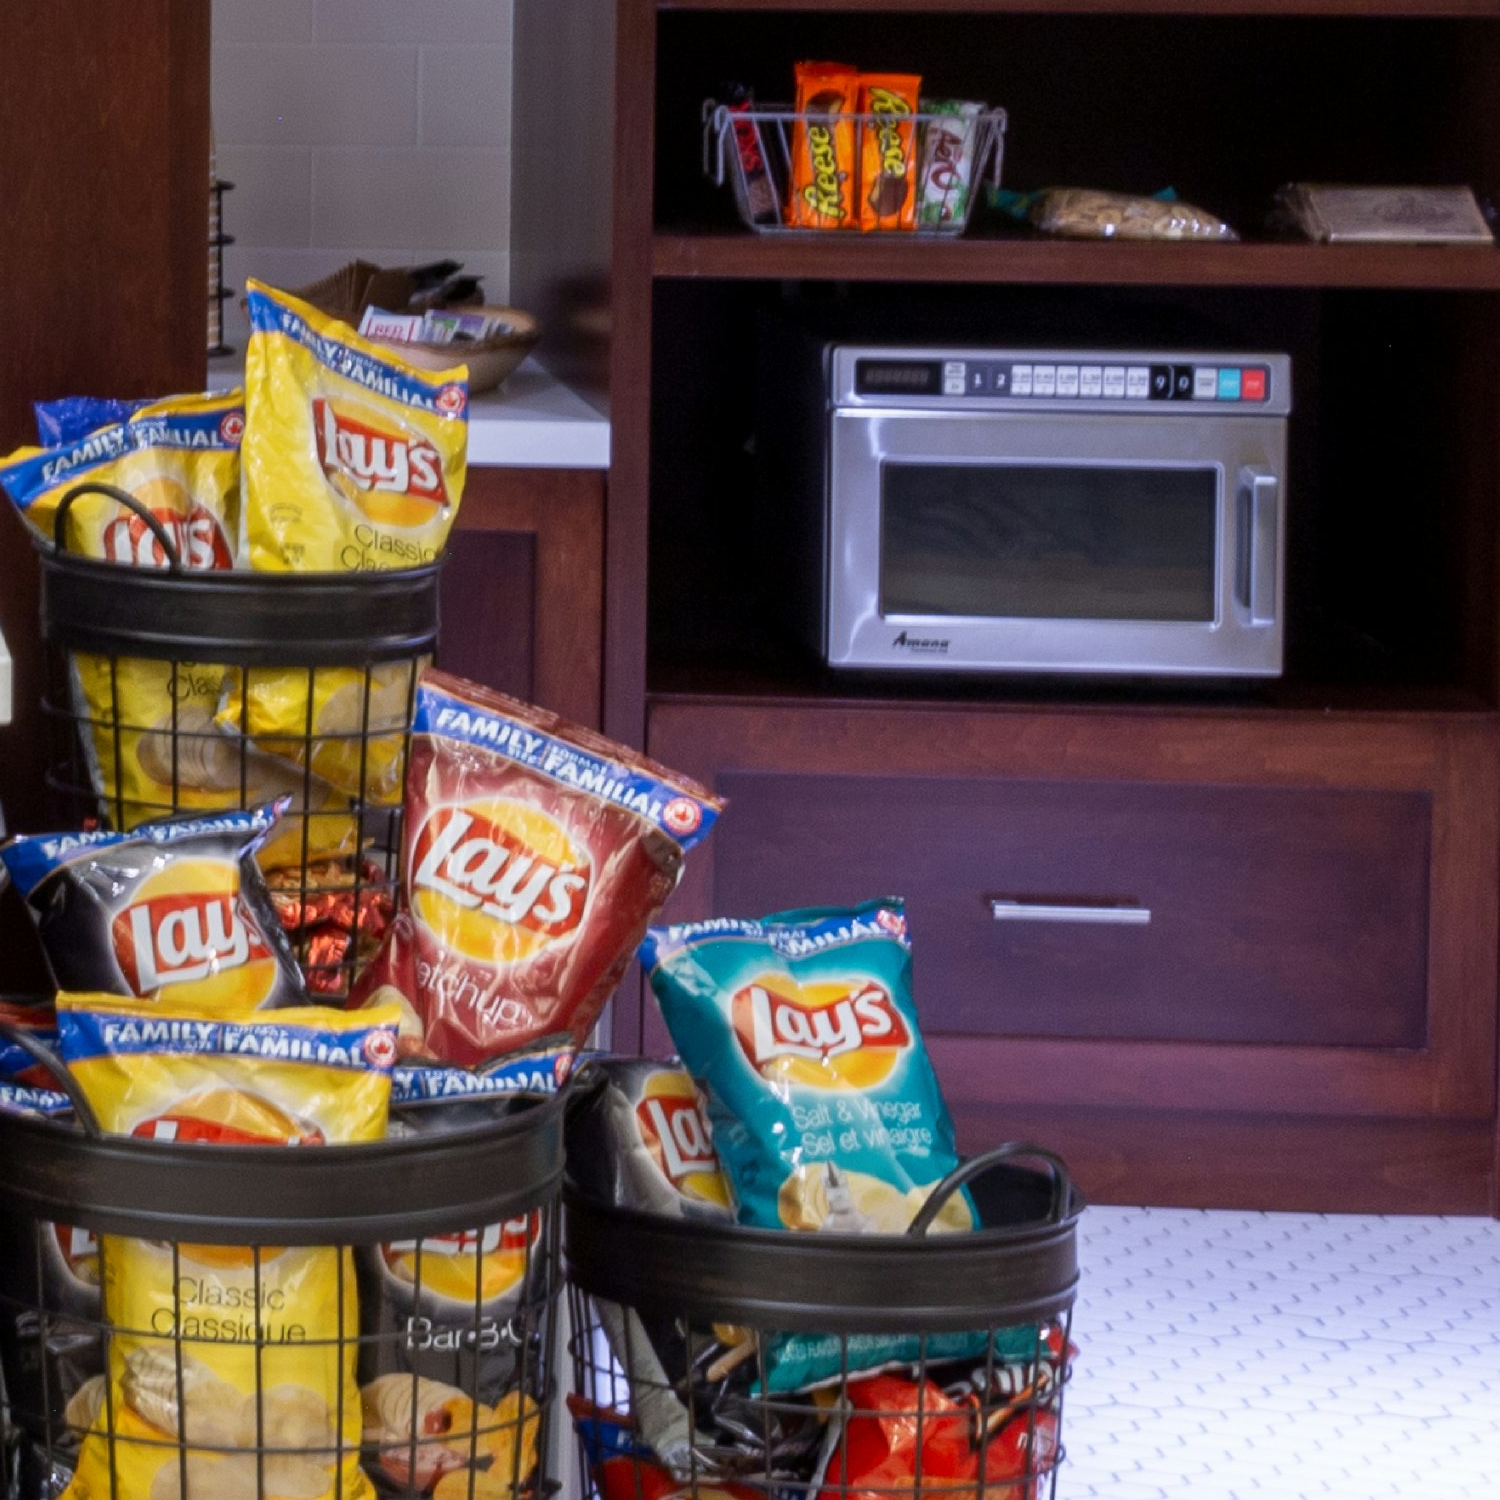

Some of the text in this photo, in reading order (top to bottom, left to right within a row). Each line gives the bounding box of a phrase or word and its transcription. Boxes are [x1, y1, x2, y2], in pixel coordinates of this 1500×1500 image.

[41, 427, 128, 483] FAMILY
[312, 399, 444, 494] Lay's
[436, 707, 663, 821] FAMILY FAMILIAL
[413, 809, 588, 923] Lay's
[103, 1022, 365, 1067] FAMILY FAMILIAL
[749, 984, 893, 1061] Lay's
[653, 1097, 714, 1179] La
[792, 1104, 833, 1130] Salt
[838, 1103, 853, 1124] &
[801, 1132, 836, 1156] Sel
[841, 1131, 860, 1152] et
[171, 1275, 286, 1311] Classic
[150, 1306, 307, 1345] Classique
